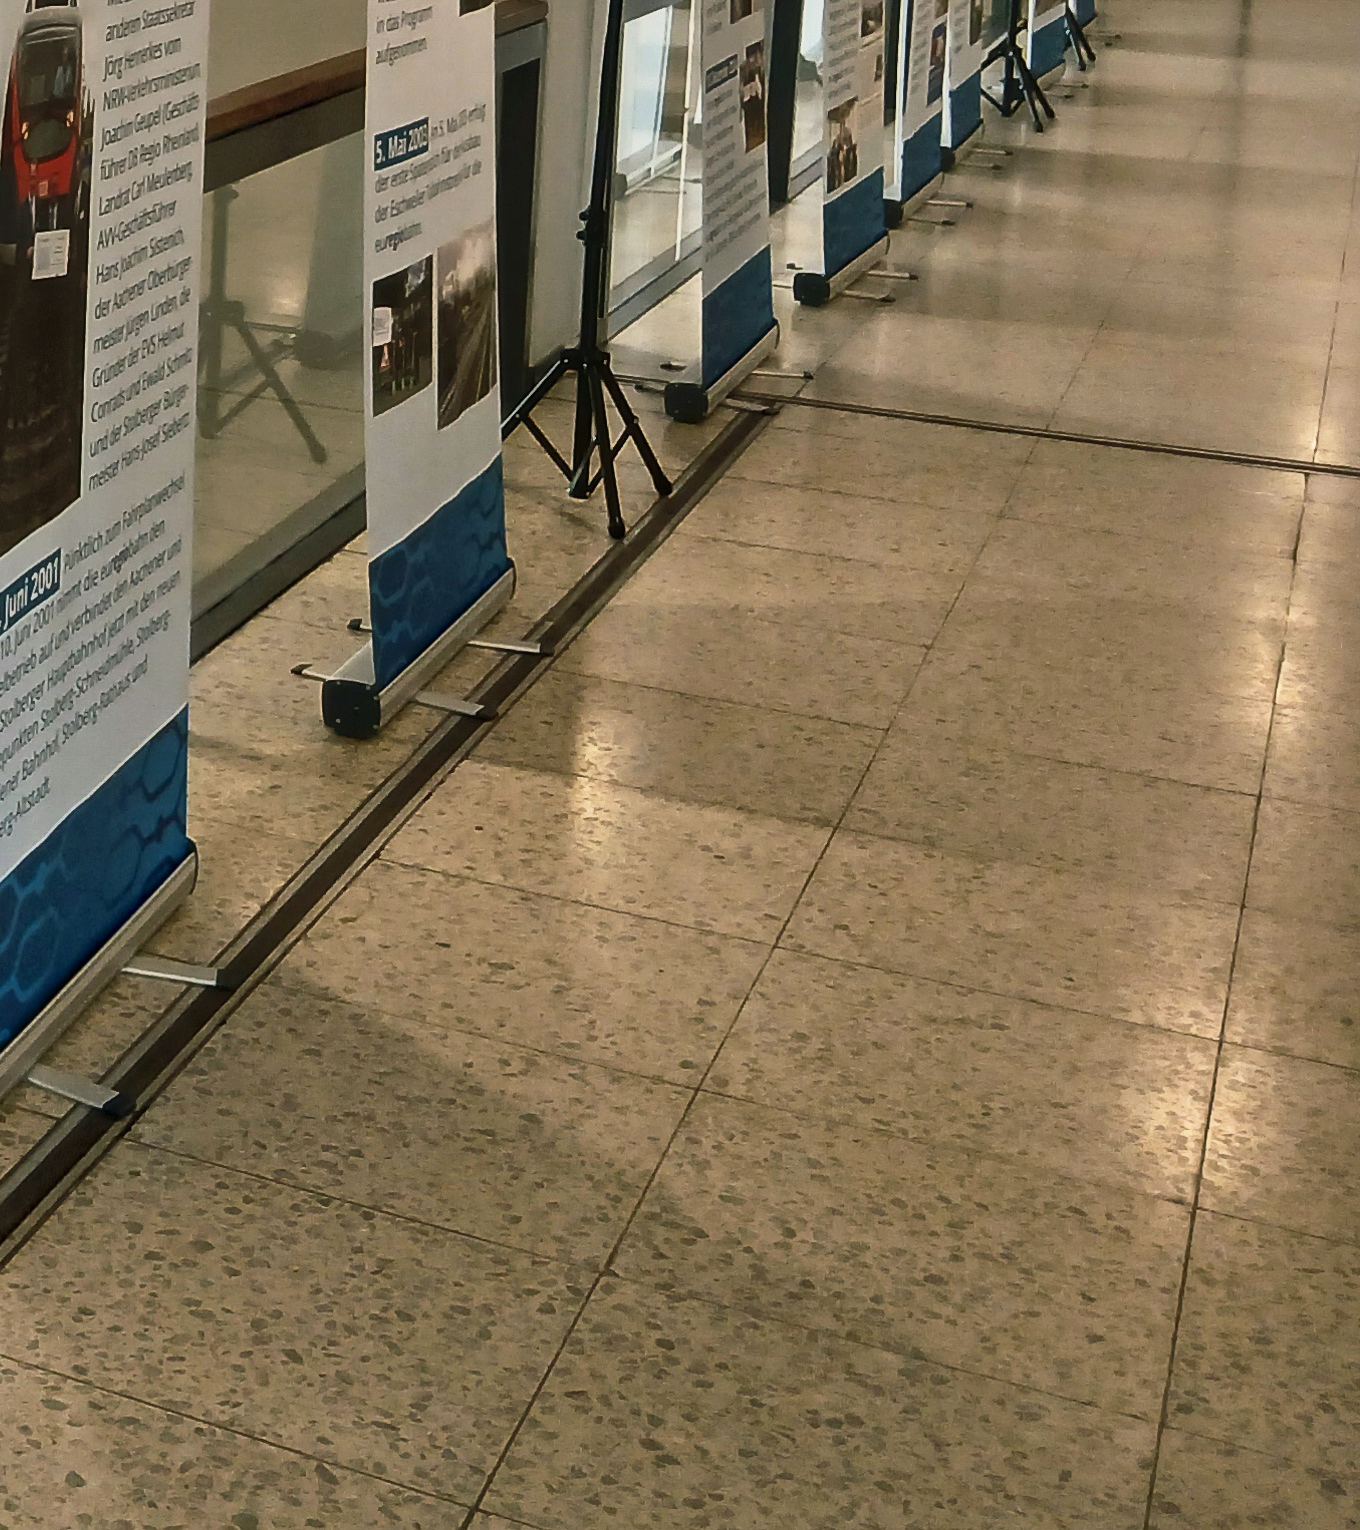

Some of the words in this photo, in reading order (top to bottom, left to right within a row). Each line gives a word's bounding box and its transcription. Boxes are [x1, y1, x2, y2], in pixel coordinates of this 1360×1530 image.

[375, 139, 386, 165] 5.
[388, 131, 408, 160] Mai
[4, 577, 29, 631] Juni
[30, 557, 59, 601] 2001
